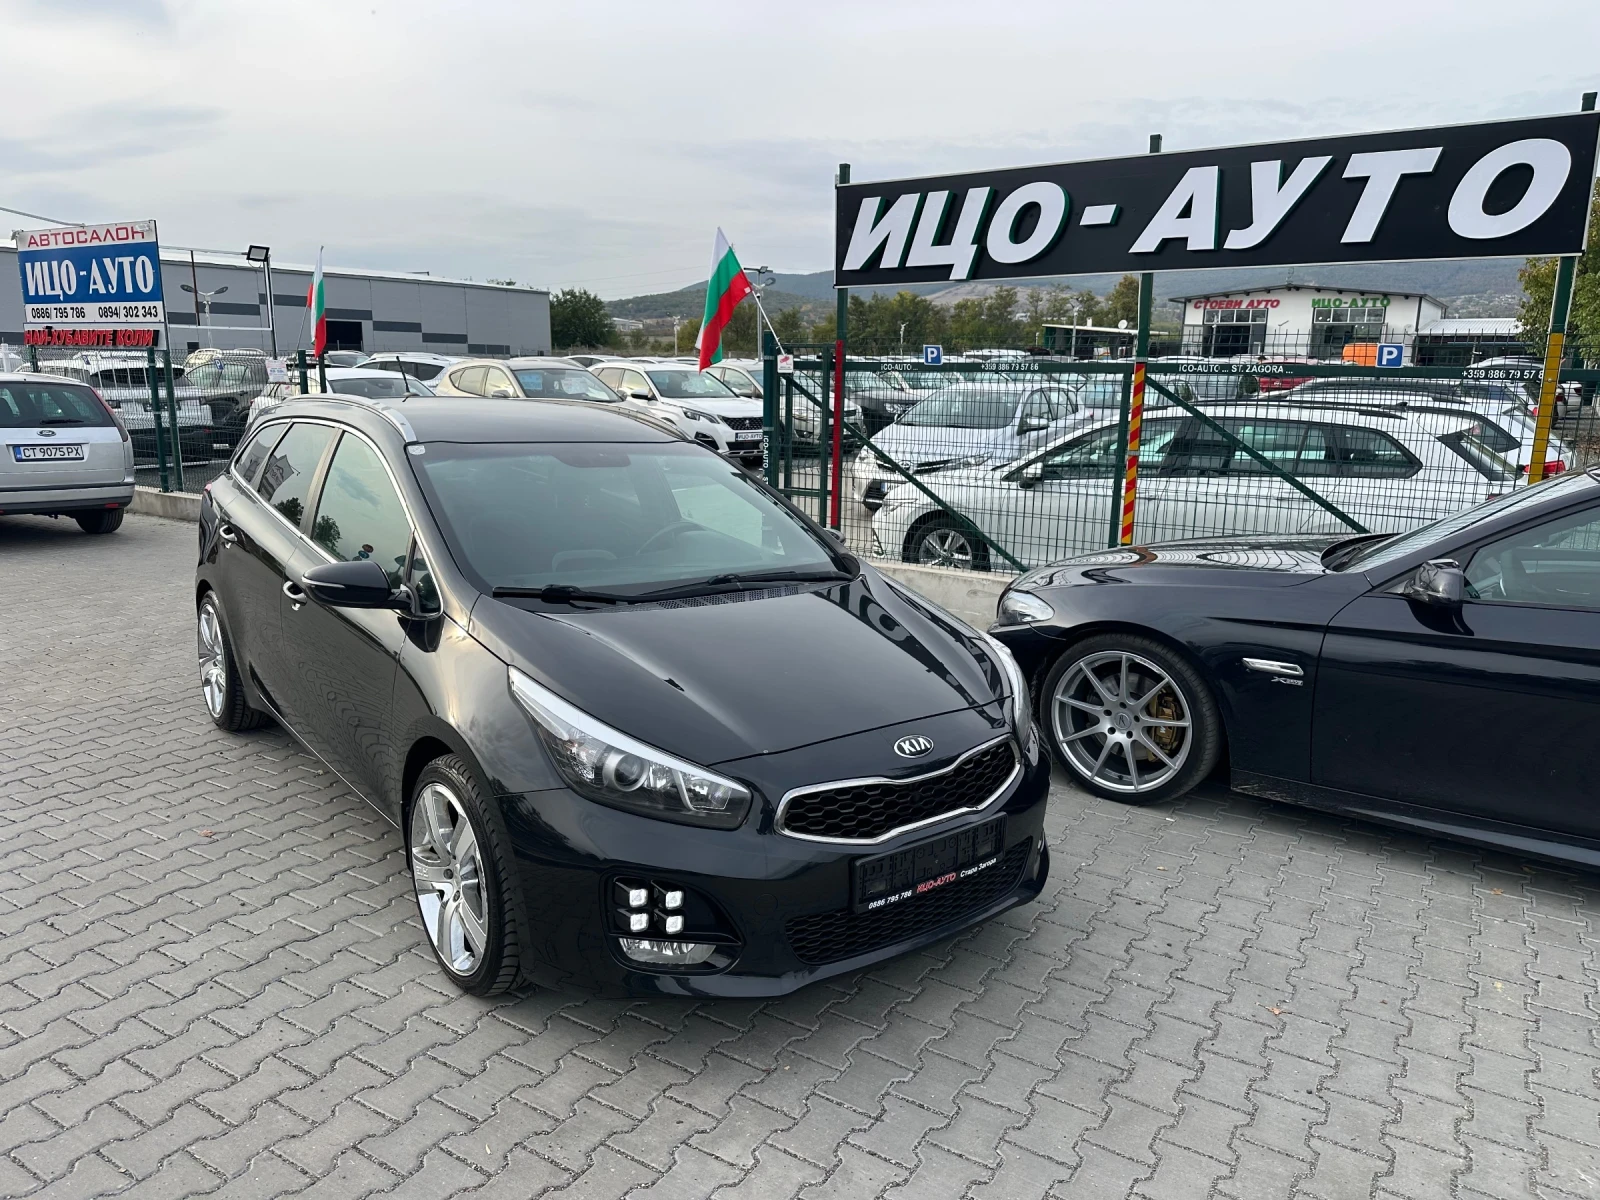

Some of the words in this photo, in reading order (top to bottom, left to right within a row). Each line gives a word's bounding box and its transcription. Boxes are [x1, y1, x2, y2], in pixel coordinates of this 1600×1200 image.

[28, 226, 145, 248] АВТОСАЛОН
[1193, 298, 1243, 309] СТОЕВИ
[1245, 298, 1281, 308] АУТО
[1311, 297, 1392, 308] ИЦО-АУТО
[53, 306, 69, 319] 795
[69, 306, 86, 319] 786
[123, 306, 140, 318] 302
[141, 305, 158, 318] 343
[116, 329, 153, 347] КОЛИ
[927, 348, 938, 362] P
[1382, 347, 1398, 365] P
[1011, 363, 1019, 371] 79
[1020, 363, 1028, 371] 57
[1030, 363, 1039, 371] 86
[1246, 365, 1284, 374] ZAGORA
[1461, 369, 1485, 379] +359
[1488, 369, 1506, 379] 886
[1508, 369, 1520, 379] 79
[1523, 369, 1535, 379] 57
[23, 447, 37, 458] CT
[39, 447, 66, 458] 9075
[66, 446, 81, 457] PX
[899, 737, 931, 754] KIA
[960, 867, 977, 878] Стара
[978, 857, 997, 872] Загора
[868, 898, 885, 910] 0886
[887, 894, 899, 904] 795
[900, 889, 912, 899] 786
